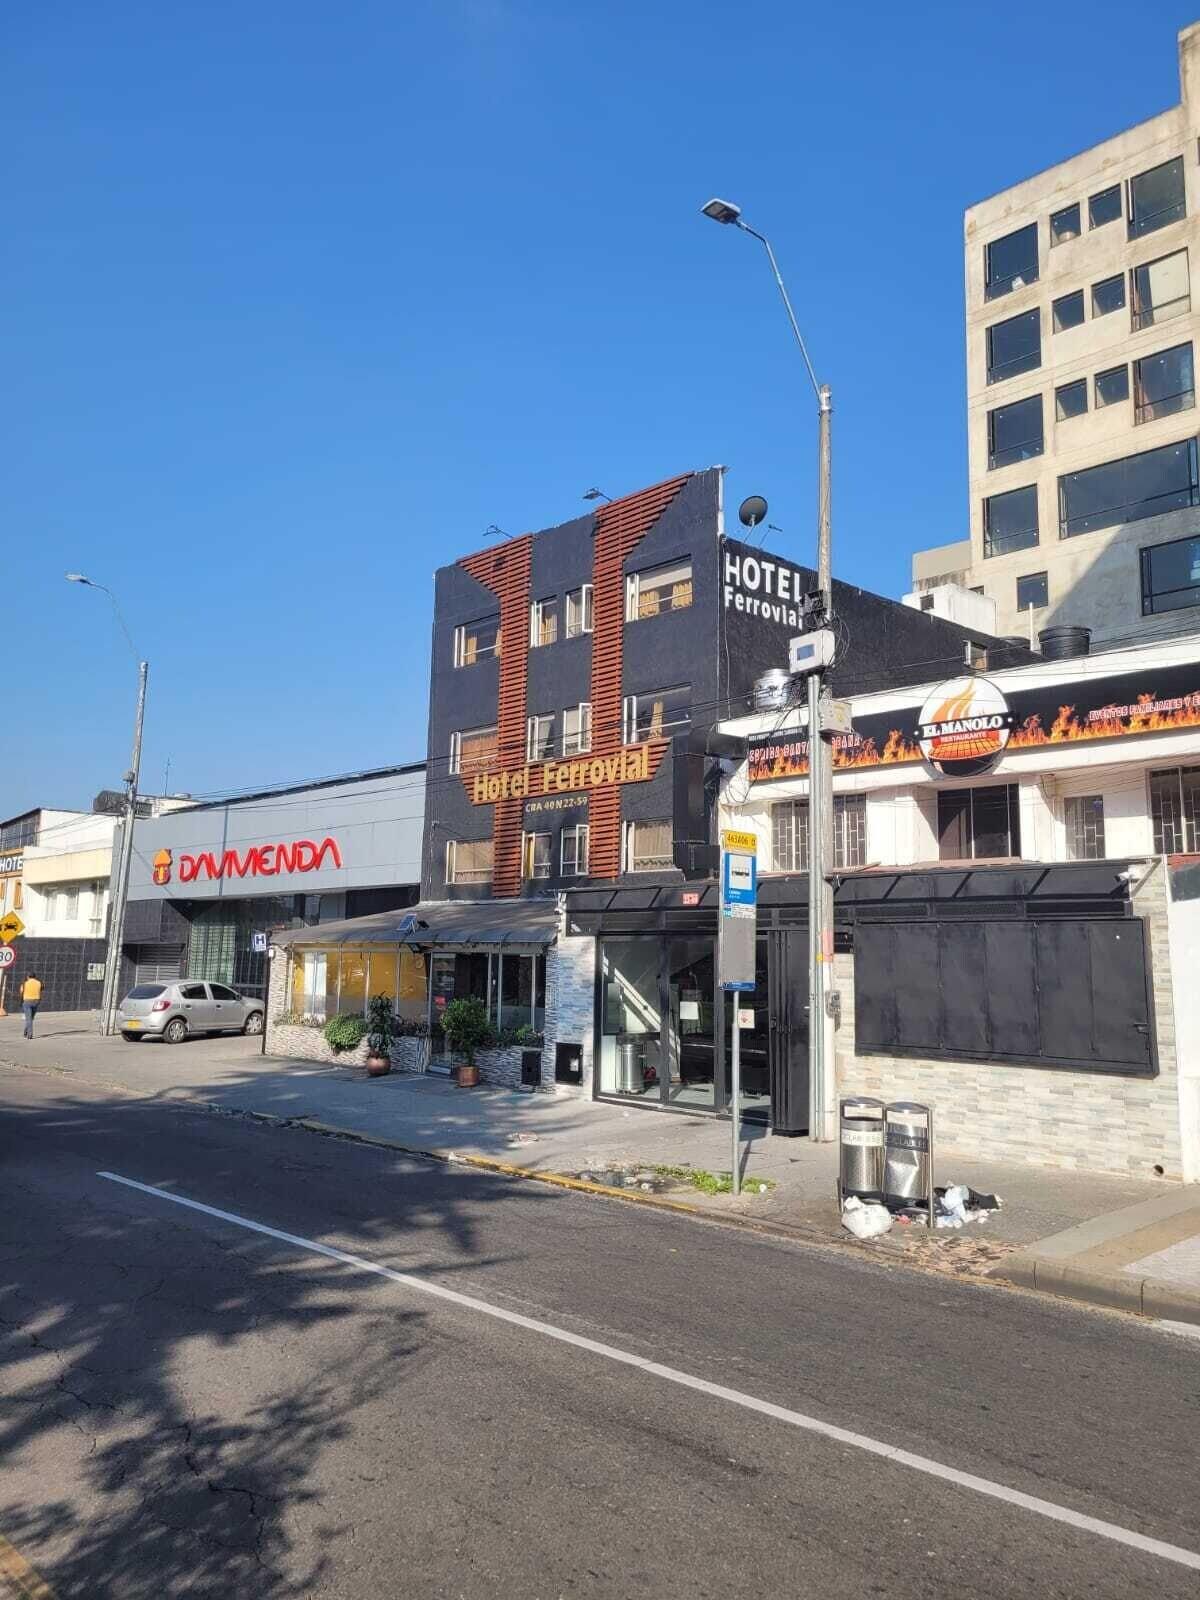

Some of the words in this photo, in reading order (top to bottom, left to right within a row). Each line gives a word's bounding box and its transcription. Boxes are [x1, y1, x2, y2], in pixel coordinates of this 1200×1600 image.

[725, 552, 803, 603] HOTEL
[922, 724, 941, 738] EL
[941, 715, 1003, 733] MANOLO
[940, 731, 988, 743] RESTAURANTE
[473, 767, 530, 803] Hotel
[543, 745, 649, 794] Ferrovial
[525, 801, 543, 813] CRA
[179, 837, 342, 883] DAVIVIENDA
